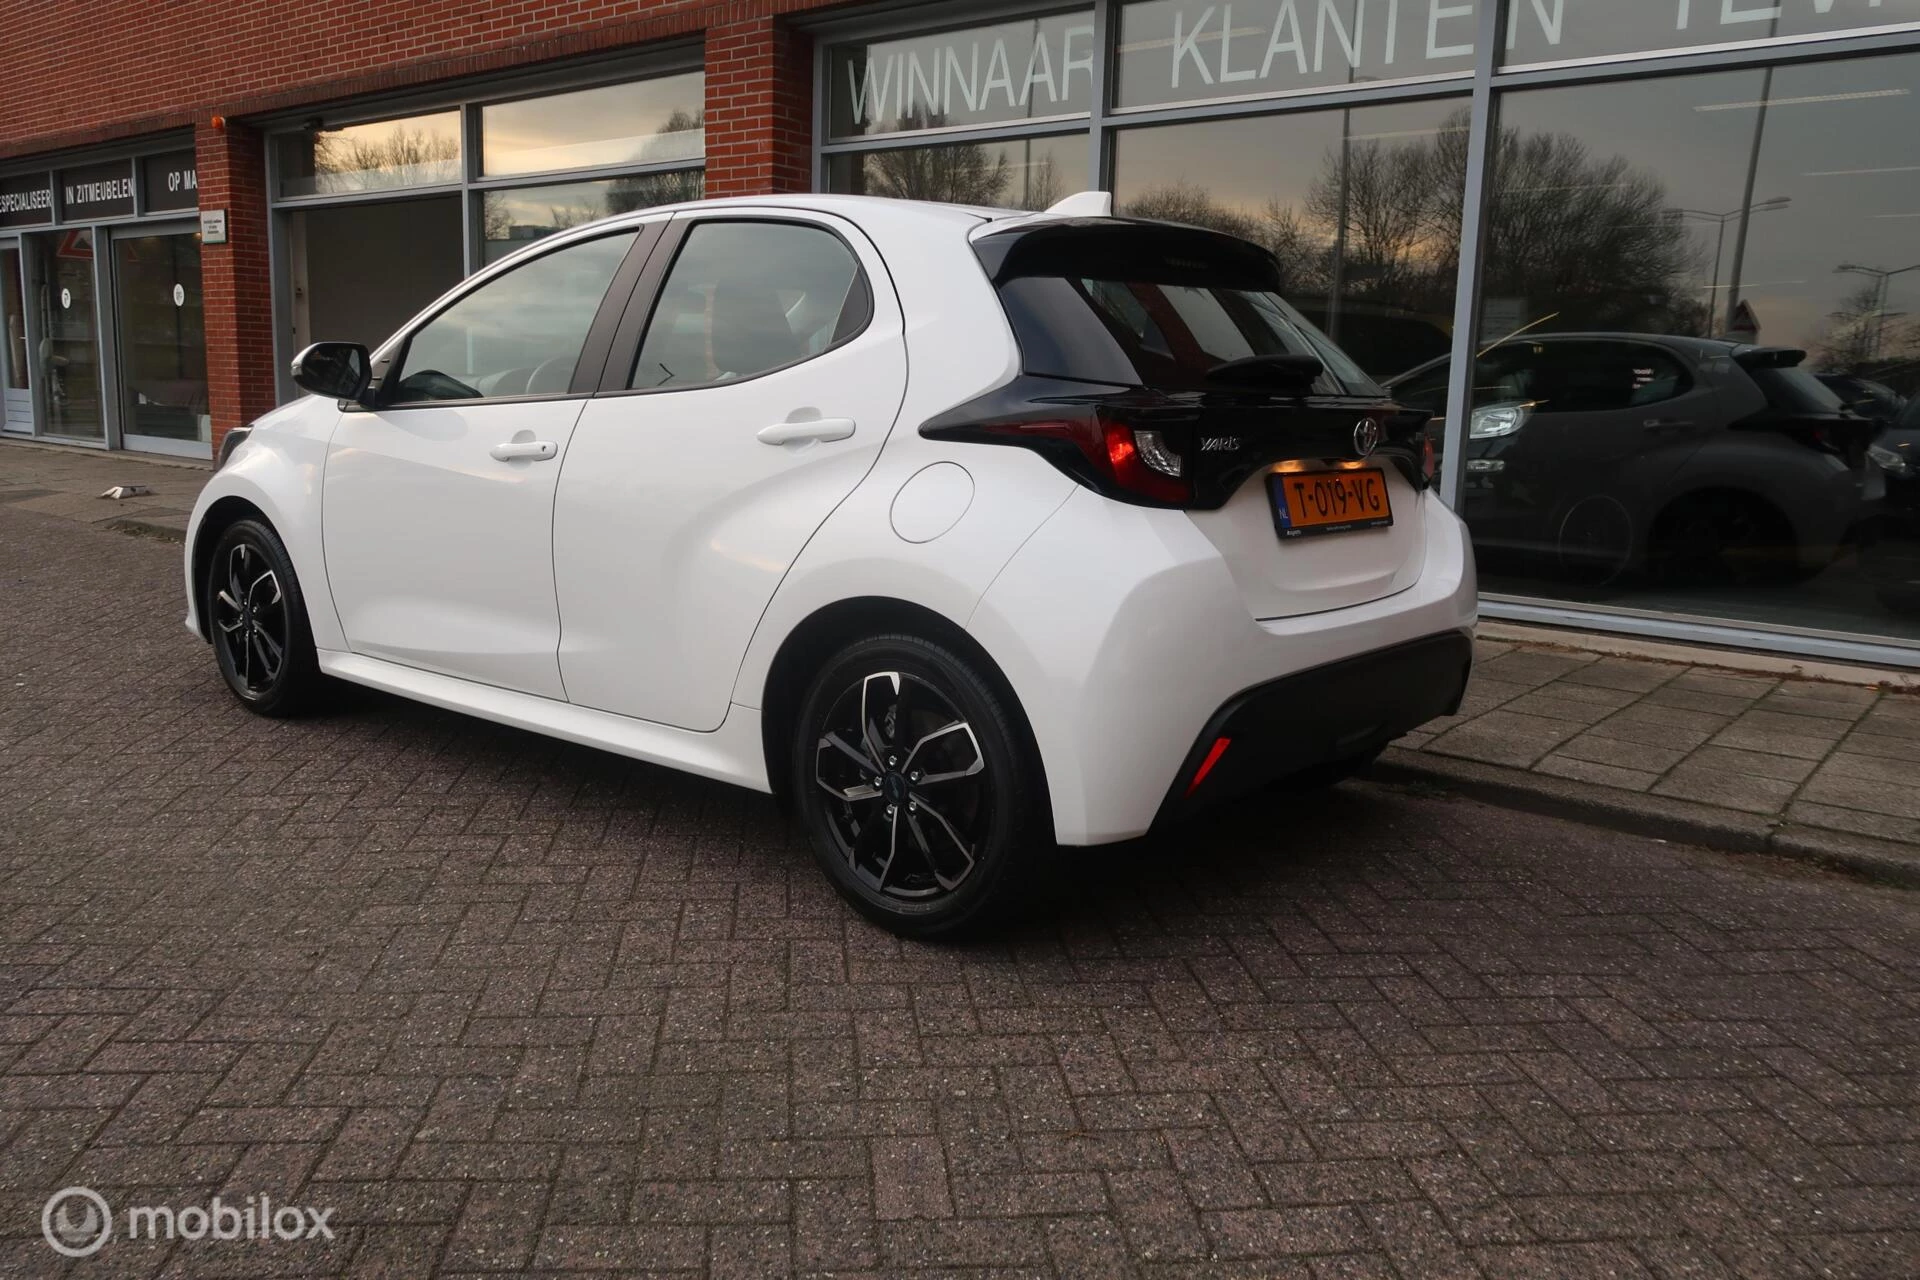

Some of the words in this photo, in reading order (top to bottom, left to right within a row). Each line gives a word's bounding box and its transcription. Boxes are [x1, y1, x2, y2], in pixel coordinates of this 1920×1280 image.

[847, 26, 1093, 125] WINNAAR
[66, 186, 74, 204] IN
[77, 178, 134, 204] ZITMEUBELEN
[168, 172, 180, 192] OP
[1280, 507, 1289, 519] NL
[1294, 479, 1380, 518] T-019-VG
